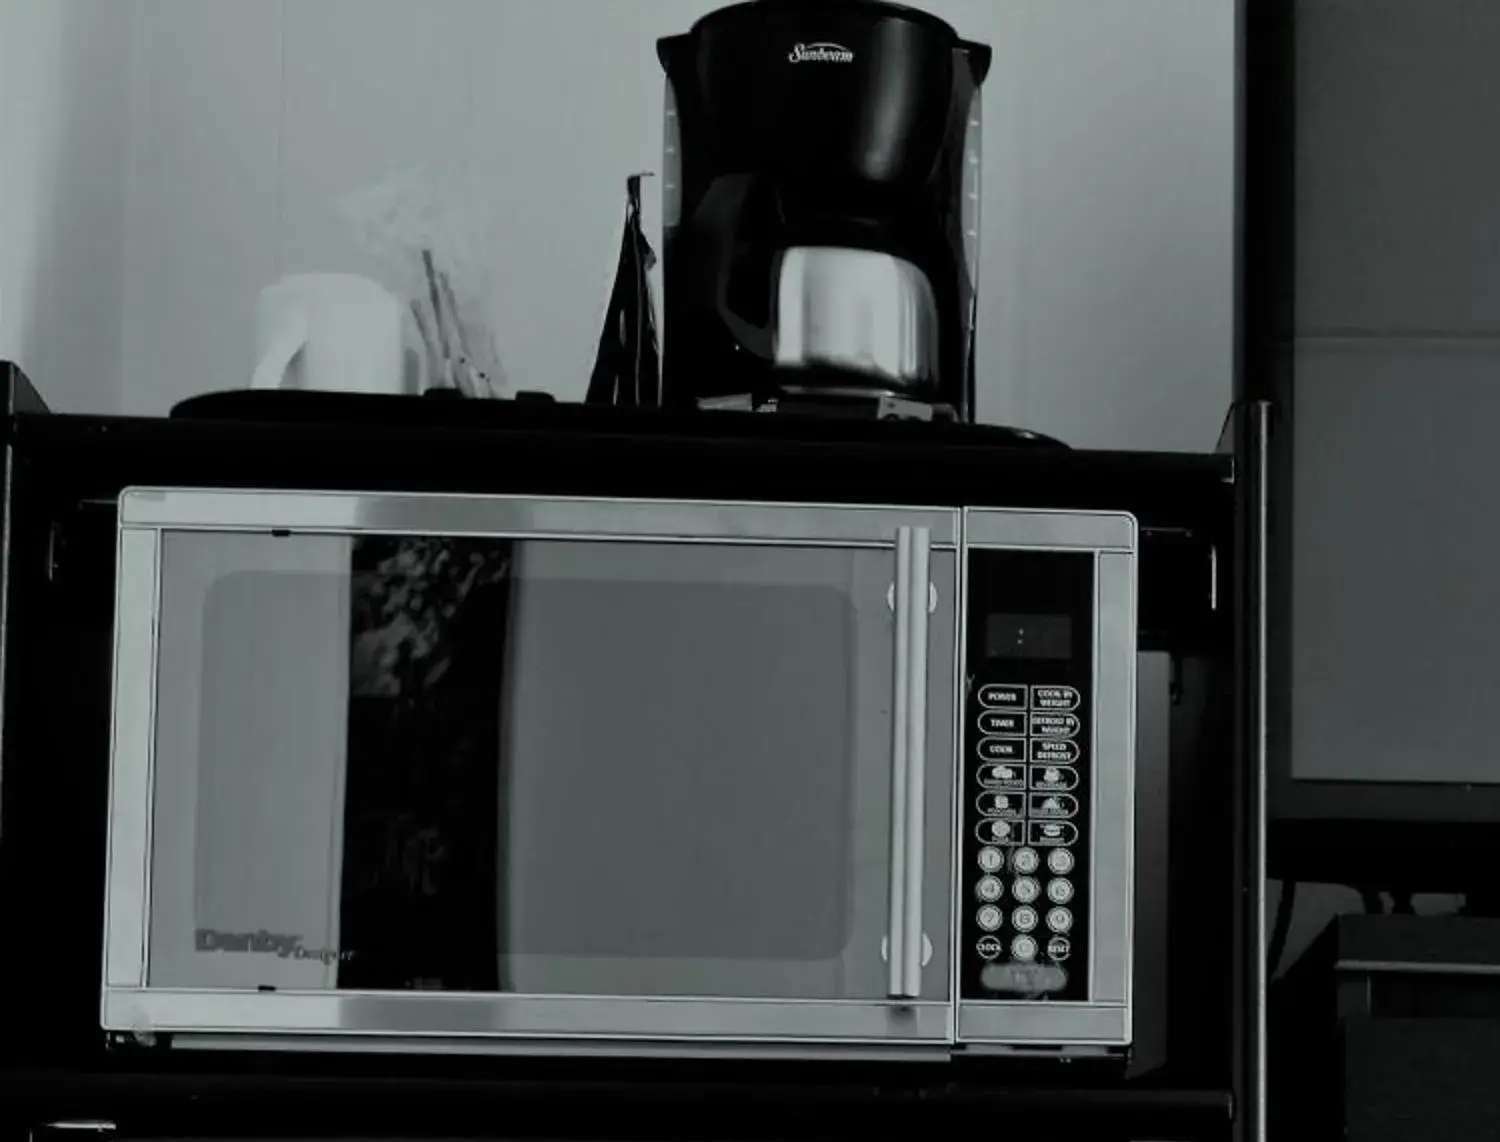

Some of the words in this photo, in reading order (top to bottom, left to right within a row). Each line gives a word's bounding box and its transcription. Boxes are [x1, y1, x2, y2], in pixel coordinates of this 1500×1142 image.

[787, 41, 855, 64] Sunbeam
[988, 692, 1017, 701] POWER
[990, 719, 1015, 727] TIMER
[195, 929, 302, 957] Danby
